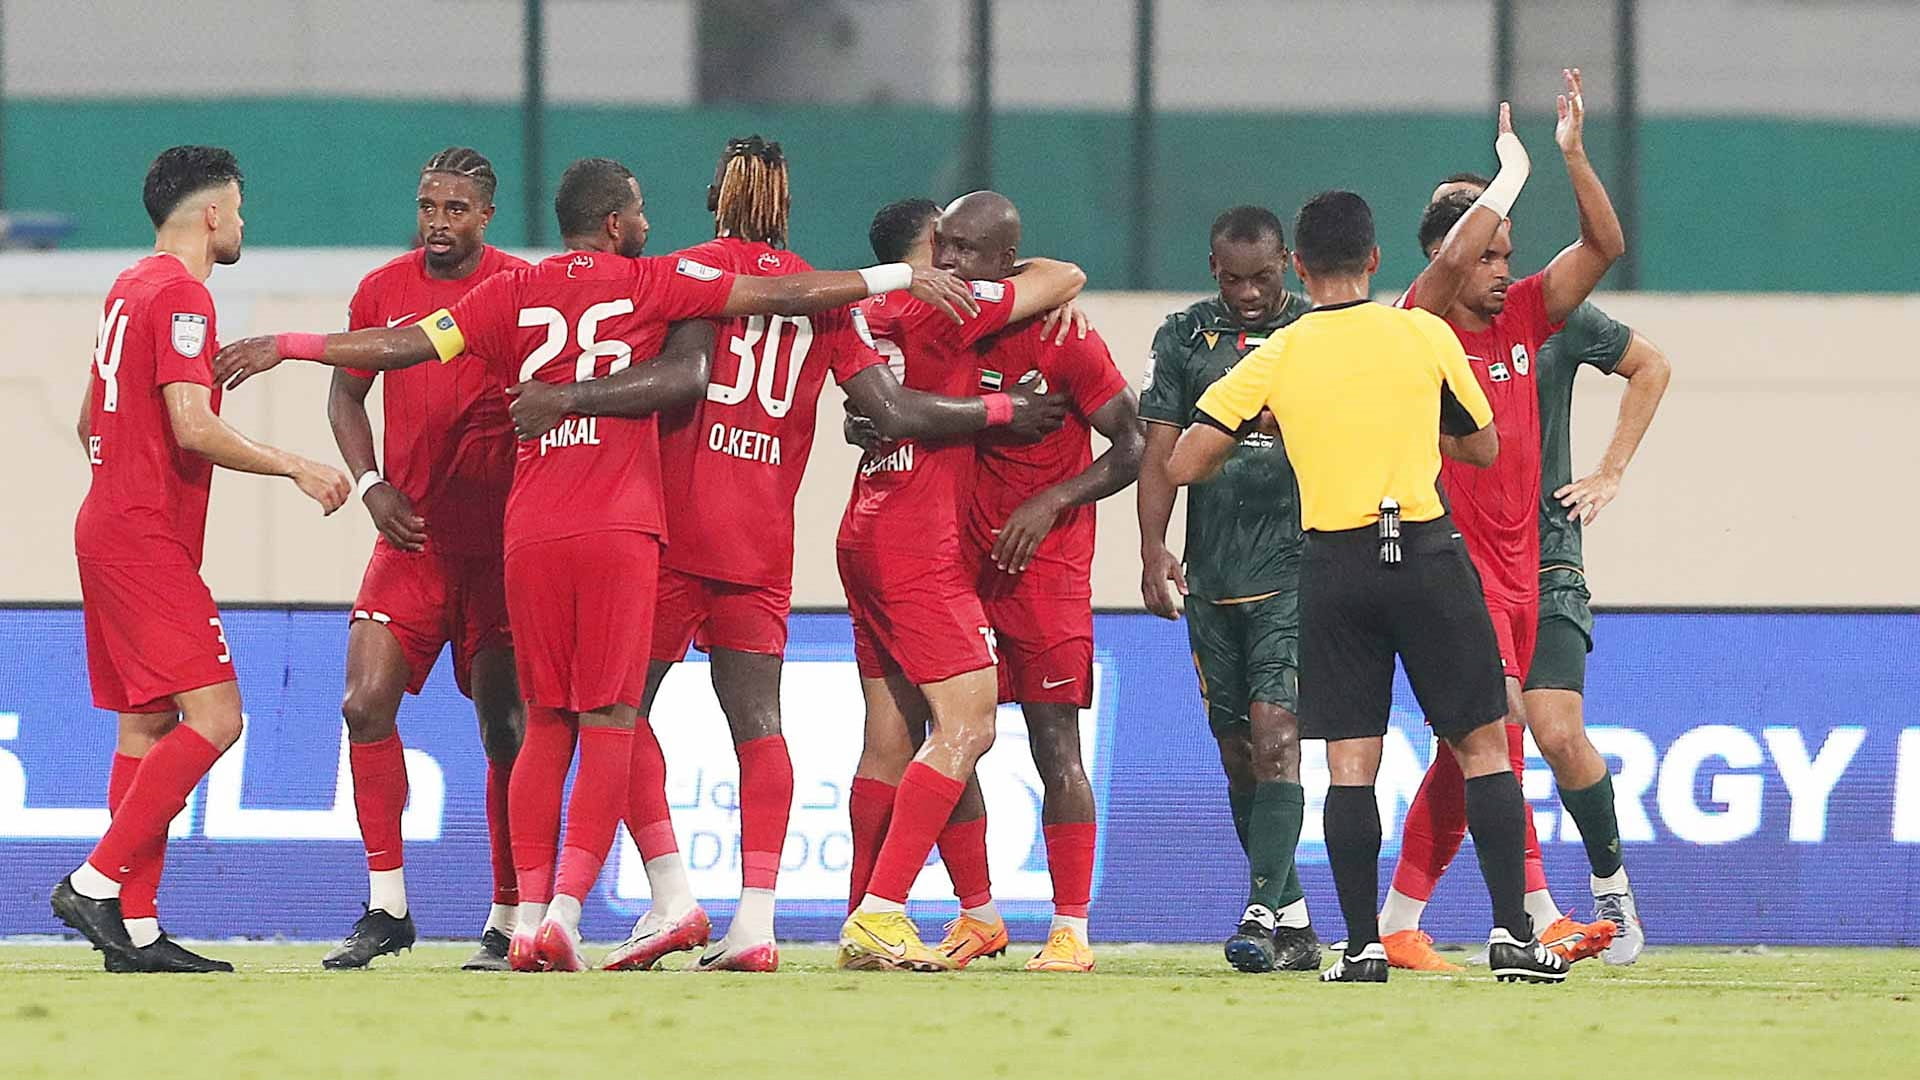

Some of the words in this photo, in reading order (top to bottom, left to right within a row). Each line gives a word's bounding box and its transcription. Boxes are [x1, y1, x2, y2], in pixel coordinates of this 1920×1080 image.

[518, 298, 634, 384] 26
[707, 314, 814, 418] 30
[708, 423, 781, 465] O.KEITA
